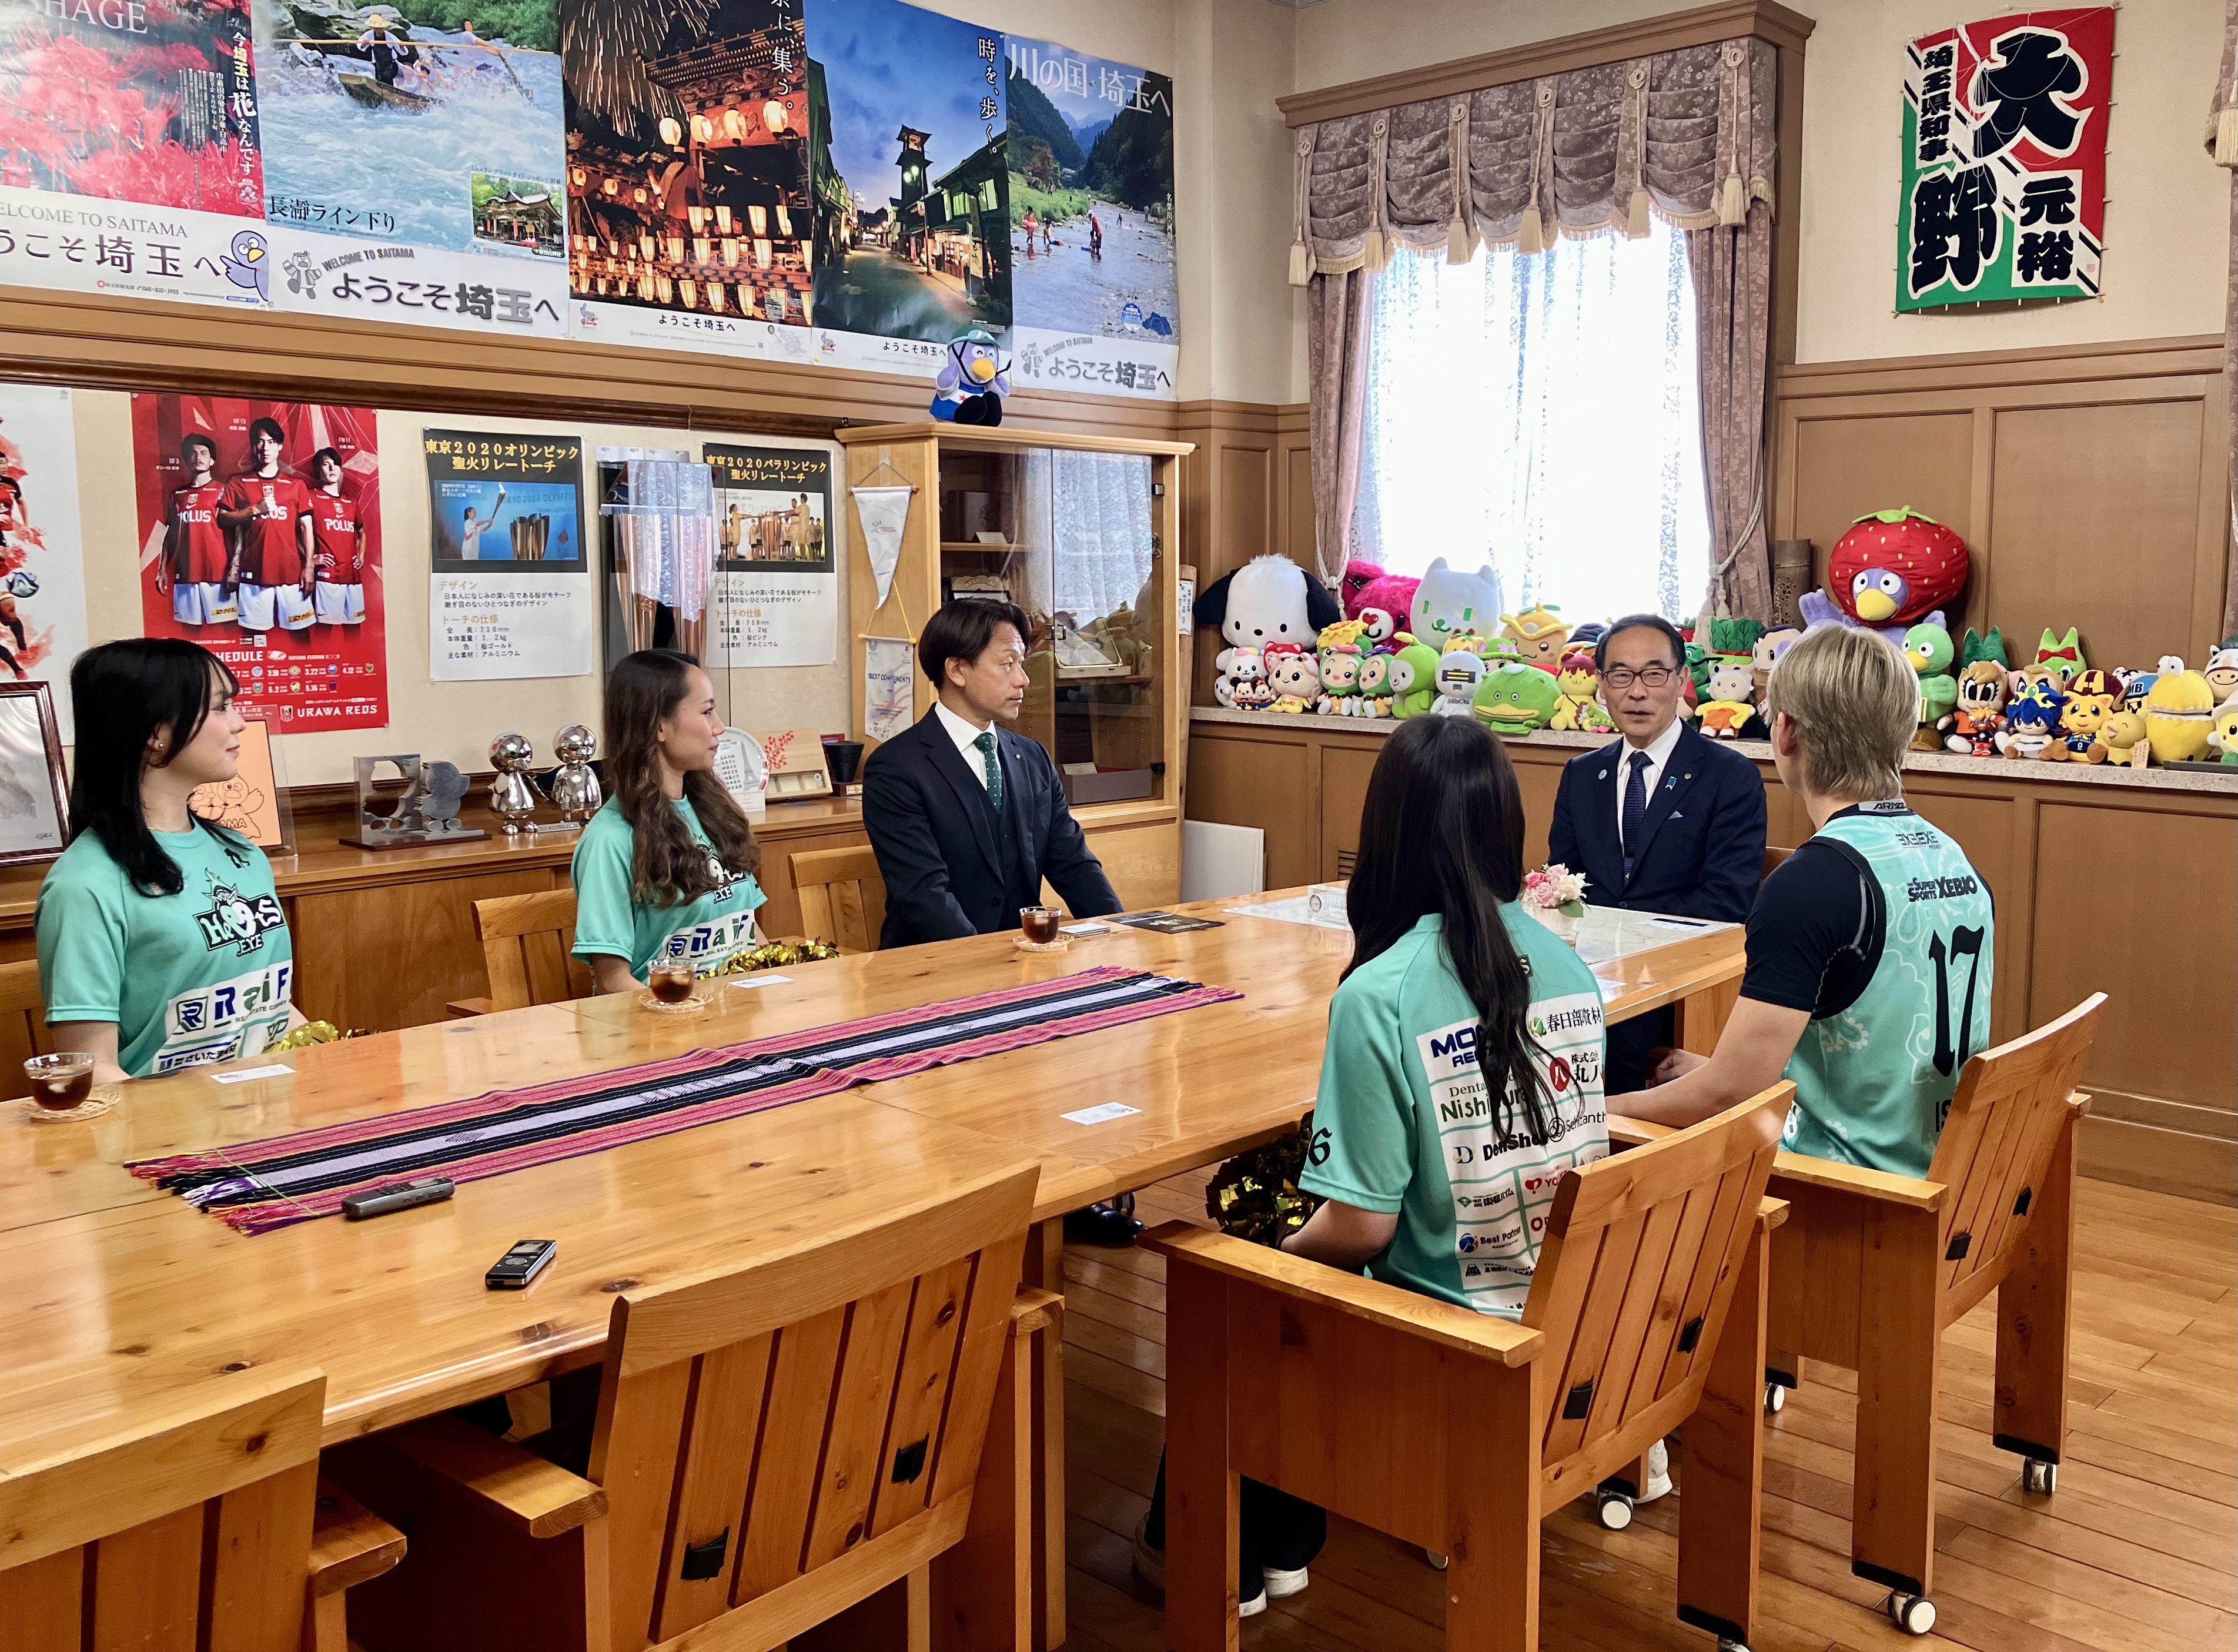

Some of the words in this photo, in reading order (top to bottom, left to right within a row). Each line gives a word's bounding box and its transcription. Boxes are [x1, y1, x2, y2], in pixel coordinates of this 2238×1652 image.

[978, 38, 998, 153] 時を、歩く。
[1919, 45, 1953, 161] 埼玉県知事
[78, 212, 102, 227] TO
[108, 216, 188, 238] SAITAMA
[2017, 176, 2076, 282] 元裕
[322, 252, 363, 271] WELCOME
[364, 250, 375, 259] TO
[377, 248, 414, 259] SAITAMA
[332, 272, 559, 324] ようこそ埼玉へ
[658, 314, 736, 332] ようこそ埼玉へ
[882, 340, 947, 357] ようこそ埼玉へ
[1043, 343, 1066, 357] WELCOME
[1073, 337, 1093, 346] SAITAMA
[1049, 357, 1171, 390] ようこそ埼玉へ
[452, 456, 556, 473] 聖火リレートーチ
[731, 469, 805, 483] 聖火リレートーチ
[324, 518, 354, 533] POLUS
[440, 581, 477, 590] デザイン
[714, 578, 745, 587] デザイン
[443, 614, 499, 624] トーチの仕様
[717, 609, 761, 618] トーチの仕様
[213, 651, 263, 662] HEDULE
[297, 707, 342, 717] URAWA
[346, 705, 377, 715] REDS
[1936, 875, 1978, 898] XEBIO
[1929, 925, 1985, 1076] 17
[1546, 1006, 1601, 1032] 春日部資材
[1449, 1082, 1486, 1097] Denta
[1480, 1235, 1499, 1244] Best
